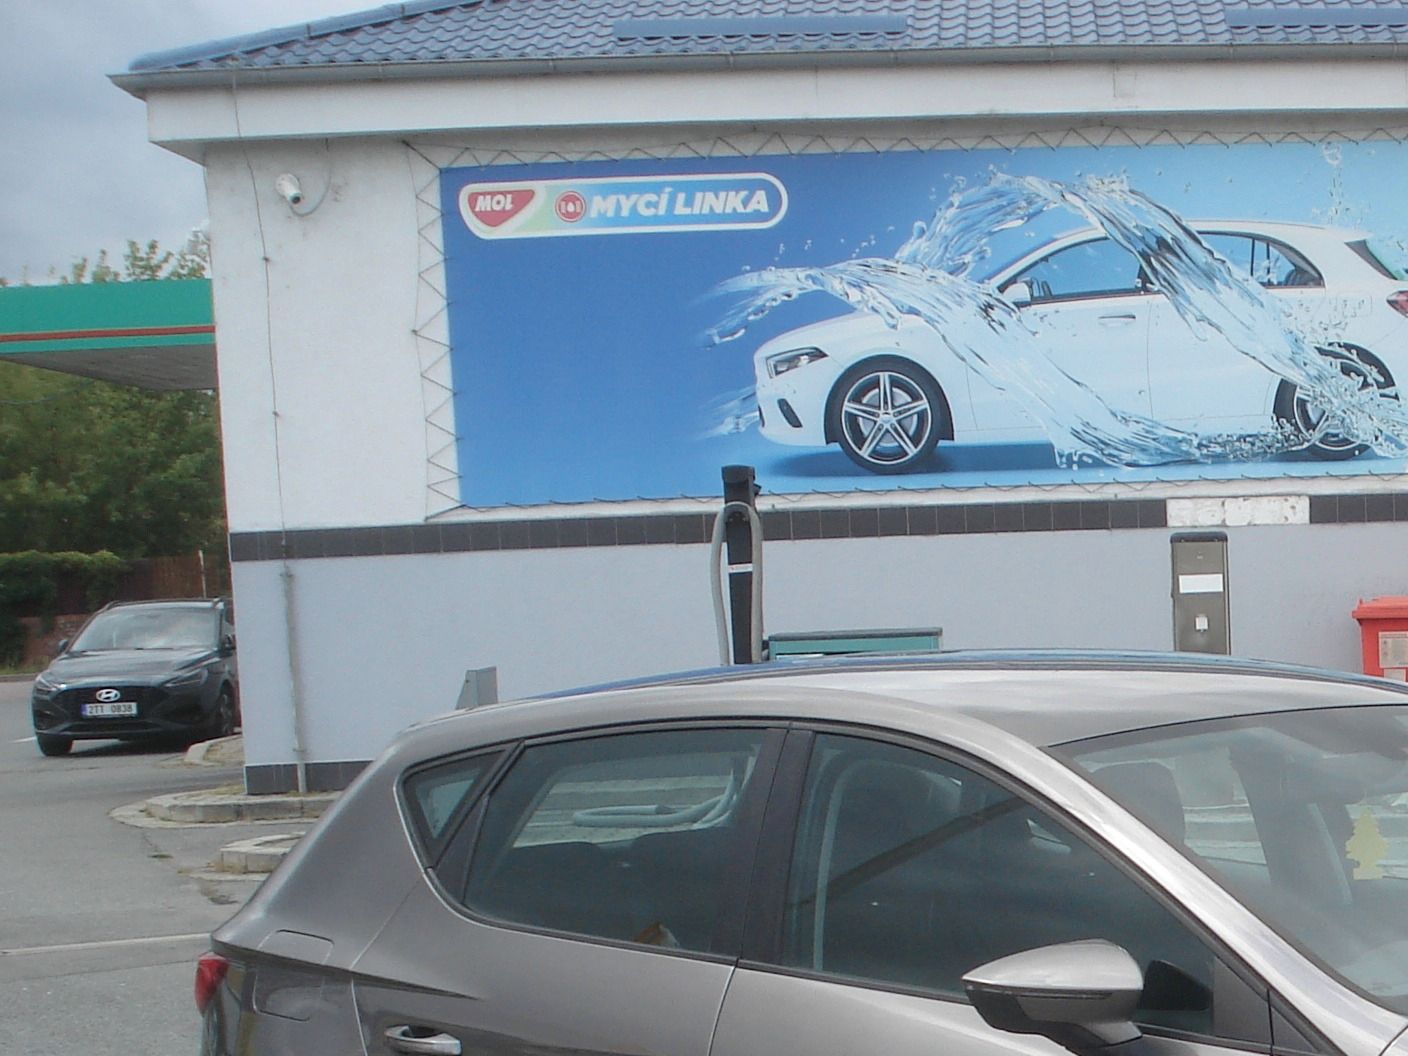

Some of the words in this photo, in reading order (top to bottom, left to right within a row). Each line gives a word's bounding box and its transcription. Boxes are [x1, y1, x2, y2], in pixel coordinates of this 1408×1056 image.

[474, 195, 514, 212] MOL
[589, 187, 672, 218] MYCÍ
[673, 190, 769, 215] LINKA
